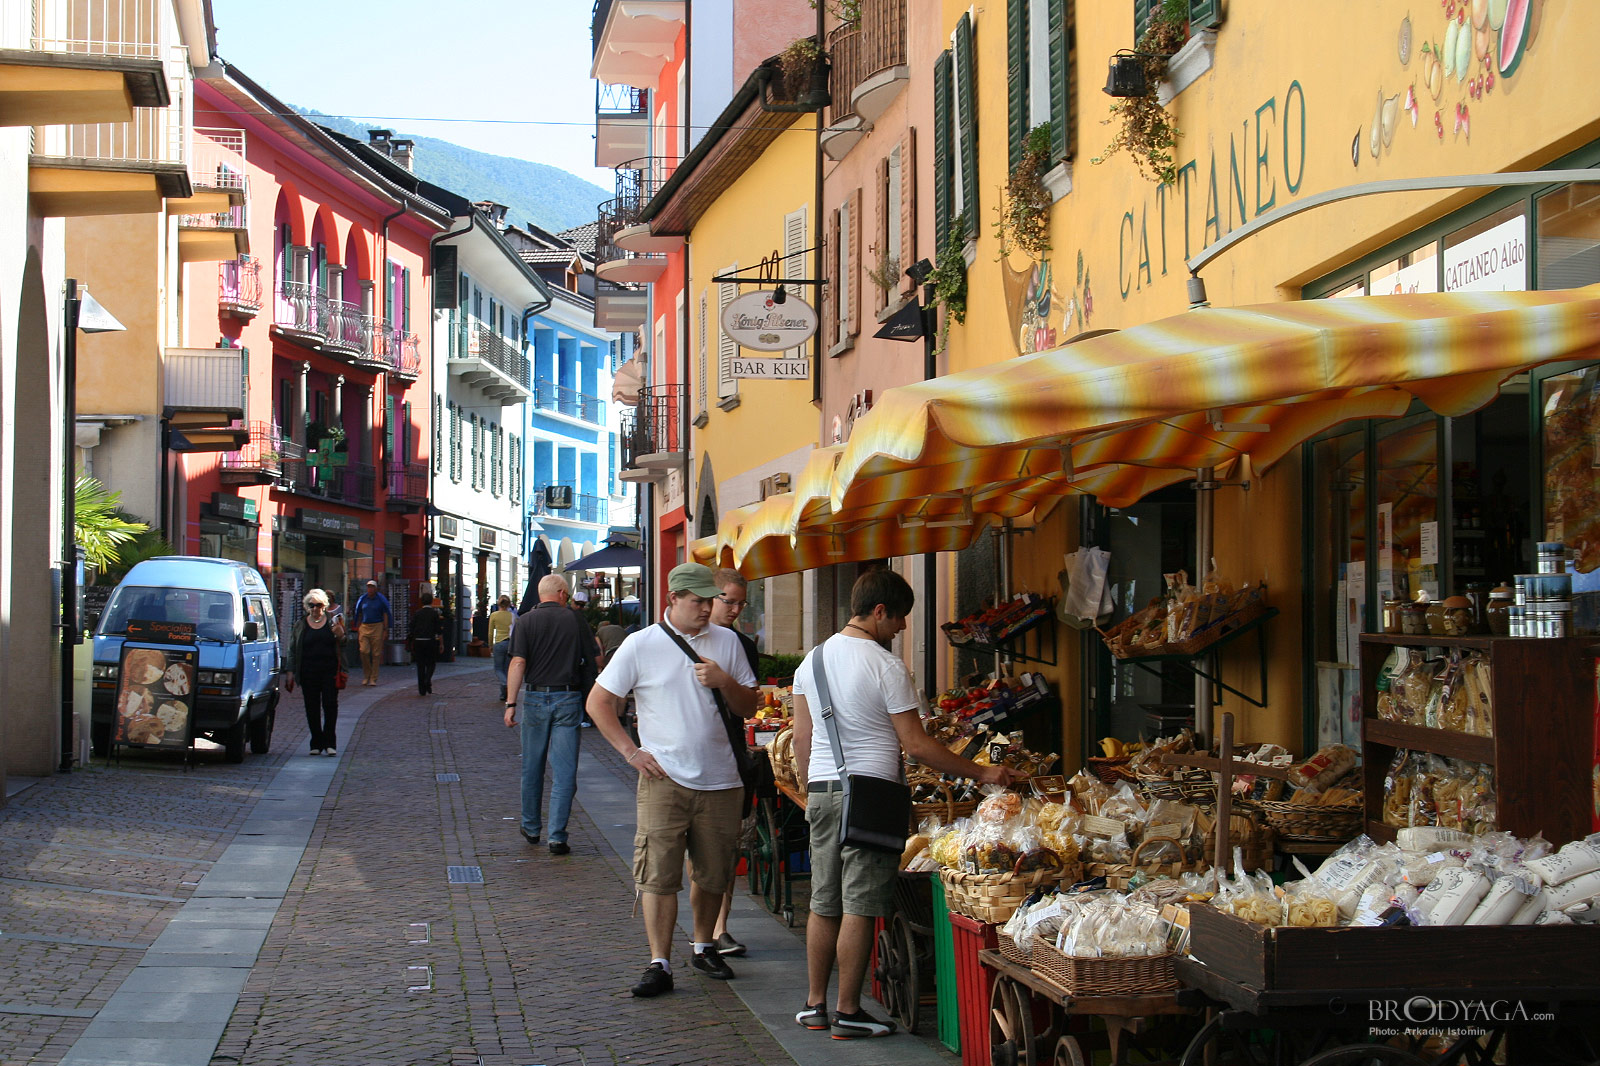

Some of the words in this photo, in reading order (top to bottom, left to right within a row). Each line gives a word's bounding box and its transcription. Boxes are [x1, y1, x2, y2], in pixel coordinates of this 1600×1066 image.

[1119, 79, 1306, 301] CATTANEO
[1445, 247, 1499, 292] CATTANEO
[1501, 238, 1525, 270] Aldo
[733, 361, 766, 375] BAR
[773, 362, 806, 375] KIKI
